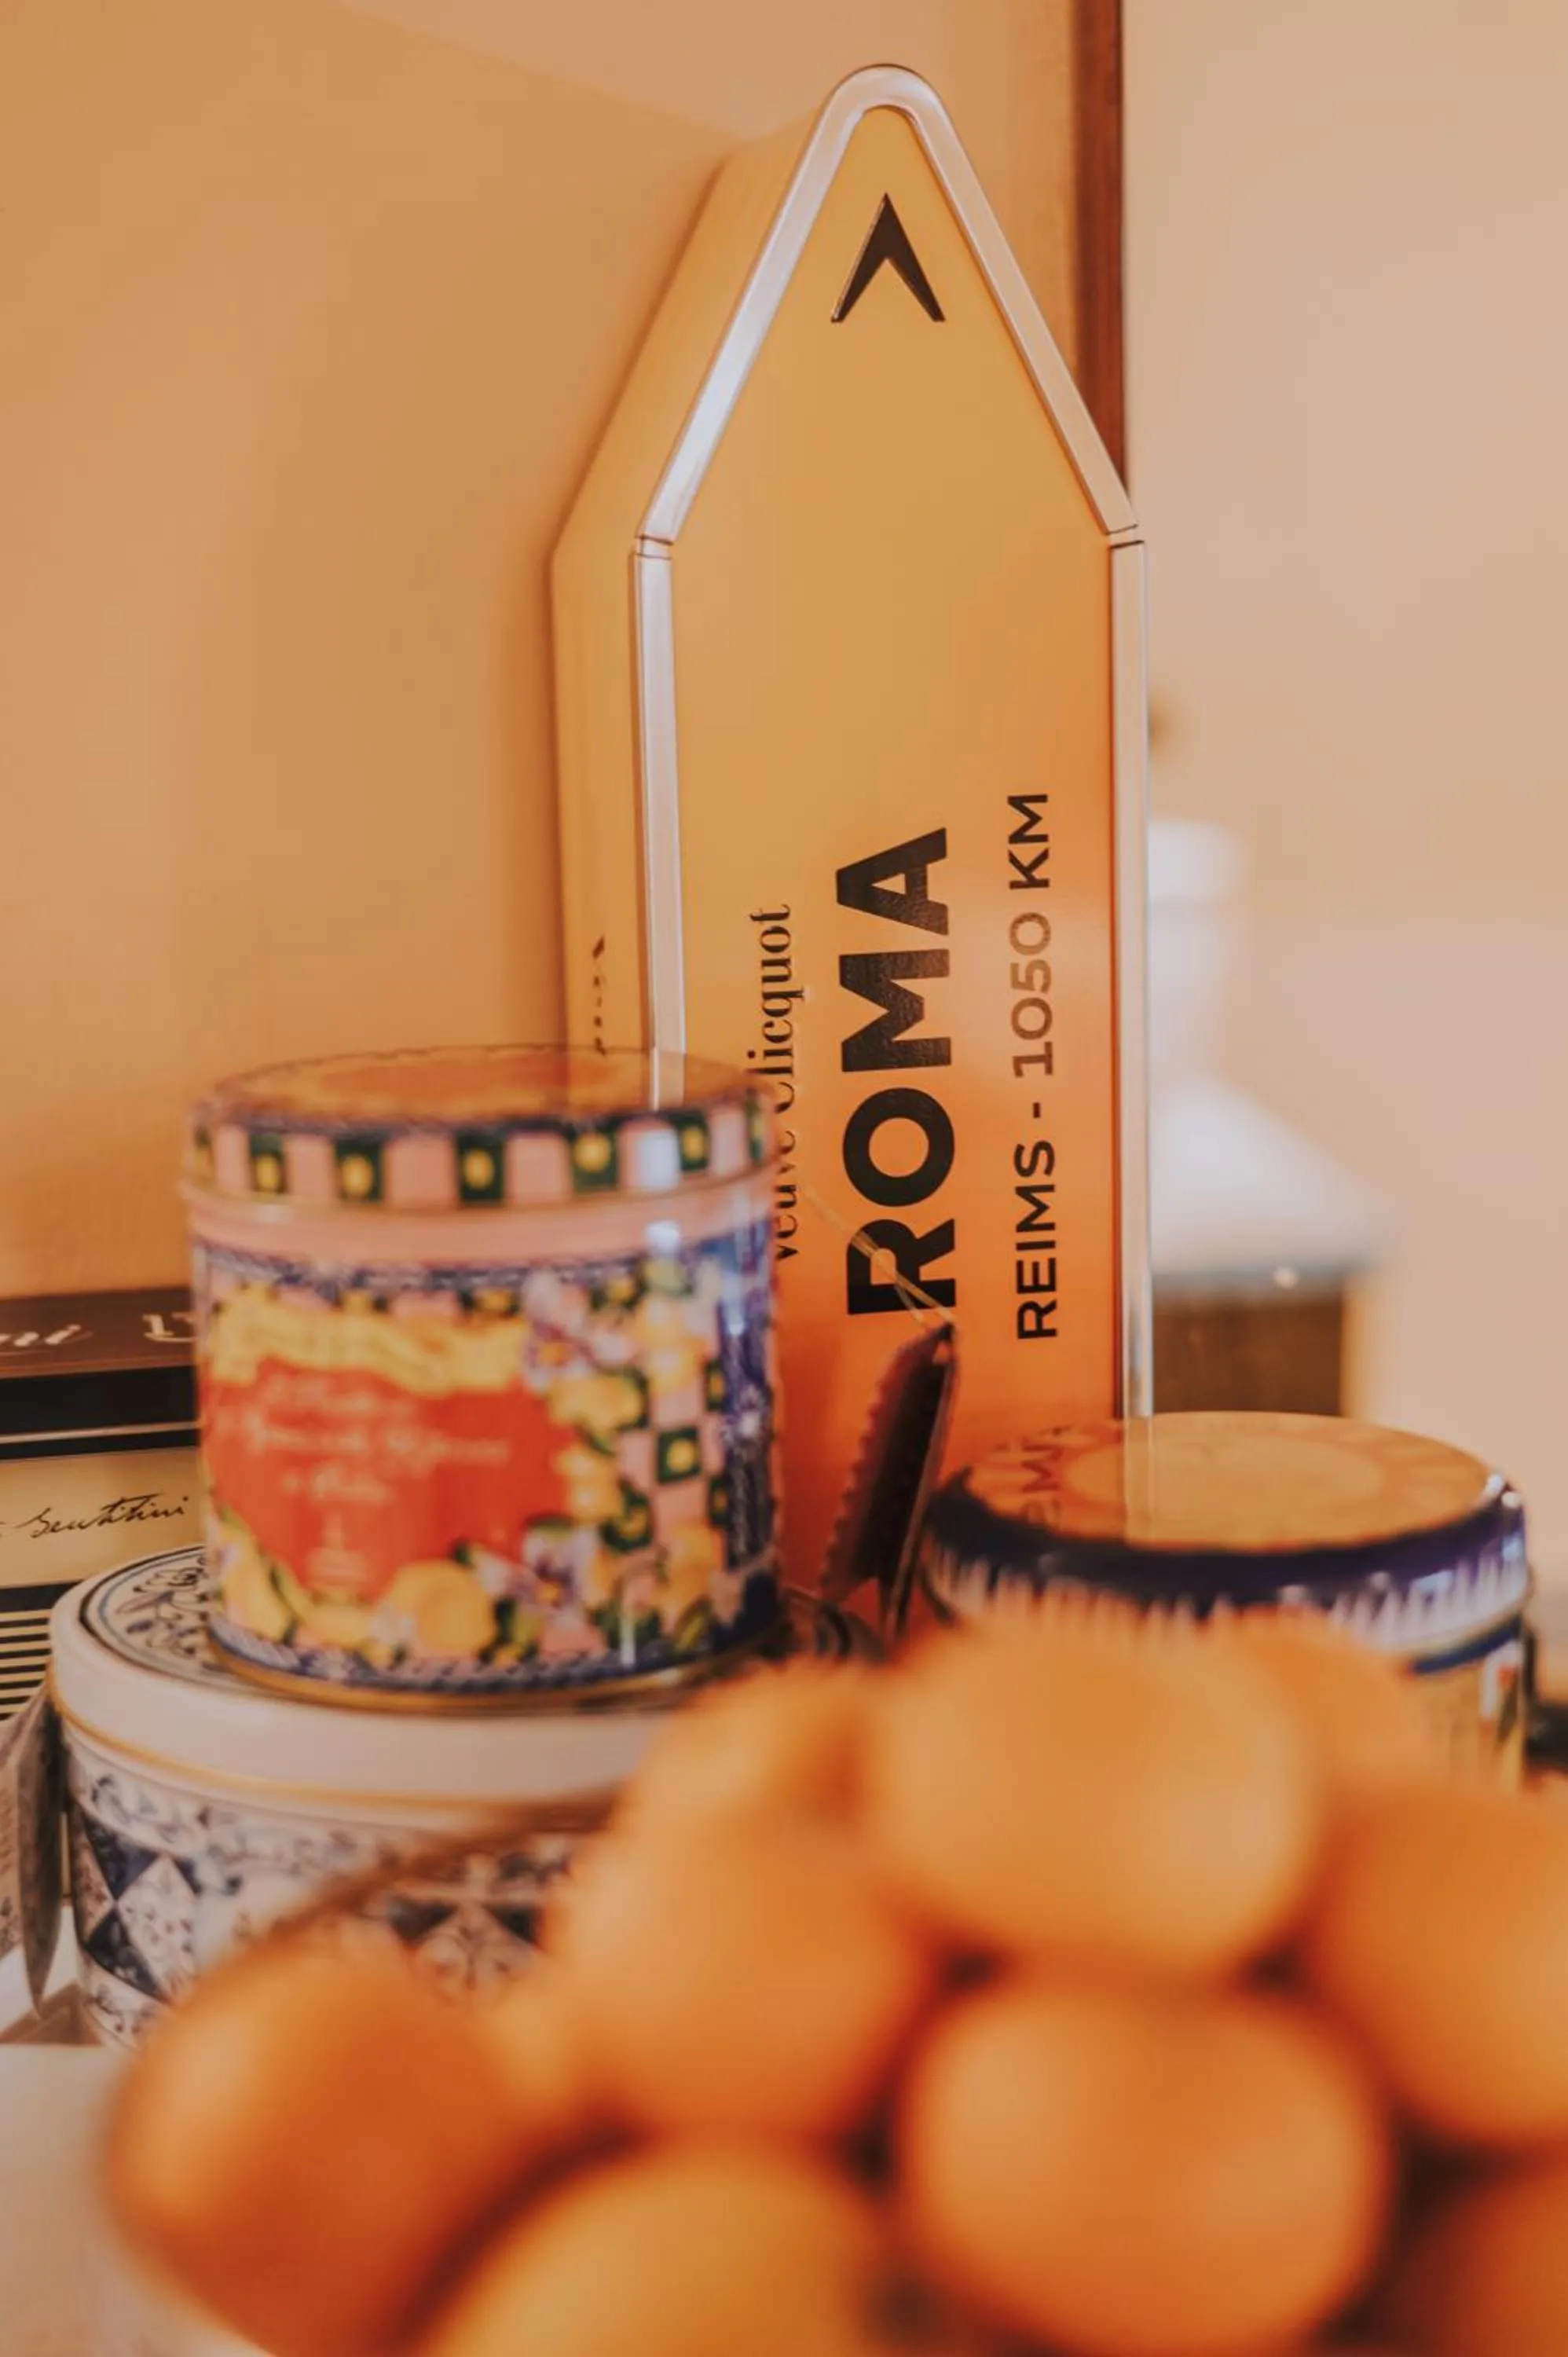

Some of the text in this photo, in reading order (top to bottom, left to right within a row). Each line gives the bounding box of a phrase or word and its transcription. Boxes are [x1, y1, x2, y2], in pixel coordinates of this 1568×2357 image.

[1007, 794, 1050, 889] KM
[835, 827, 956, 1315] ROMA
[1009, 911, 1053, 1078] 1050
[1013, 1140, 1057, 1340] REIMS
